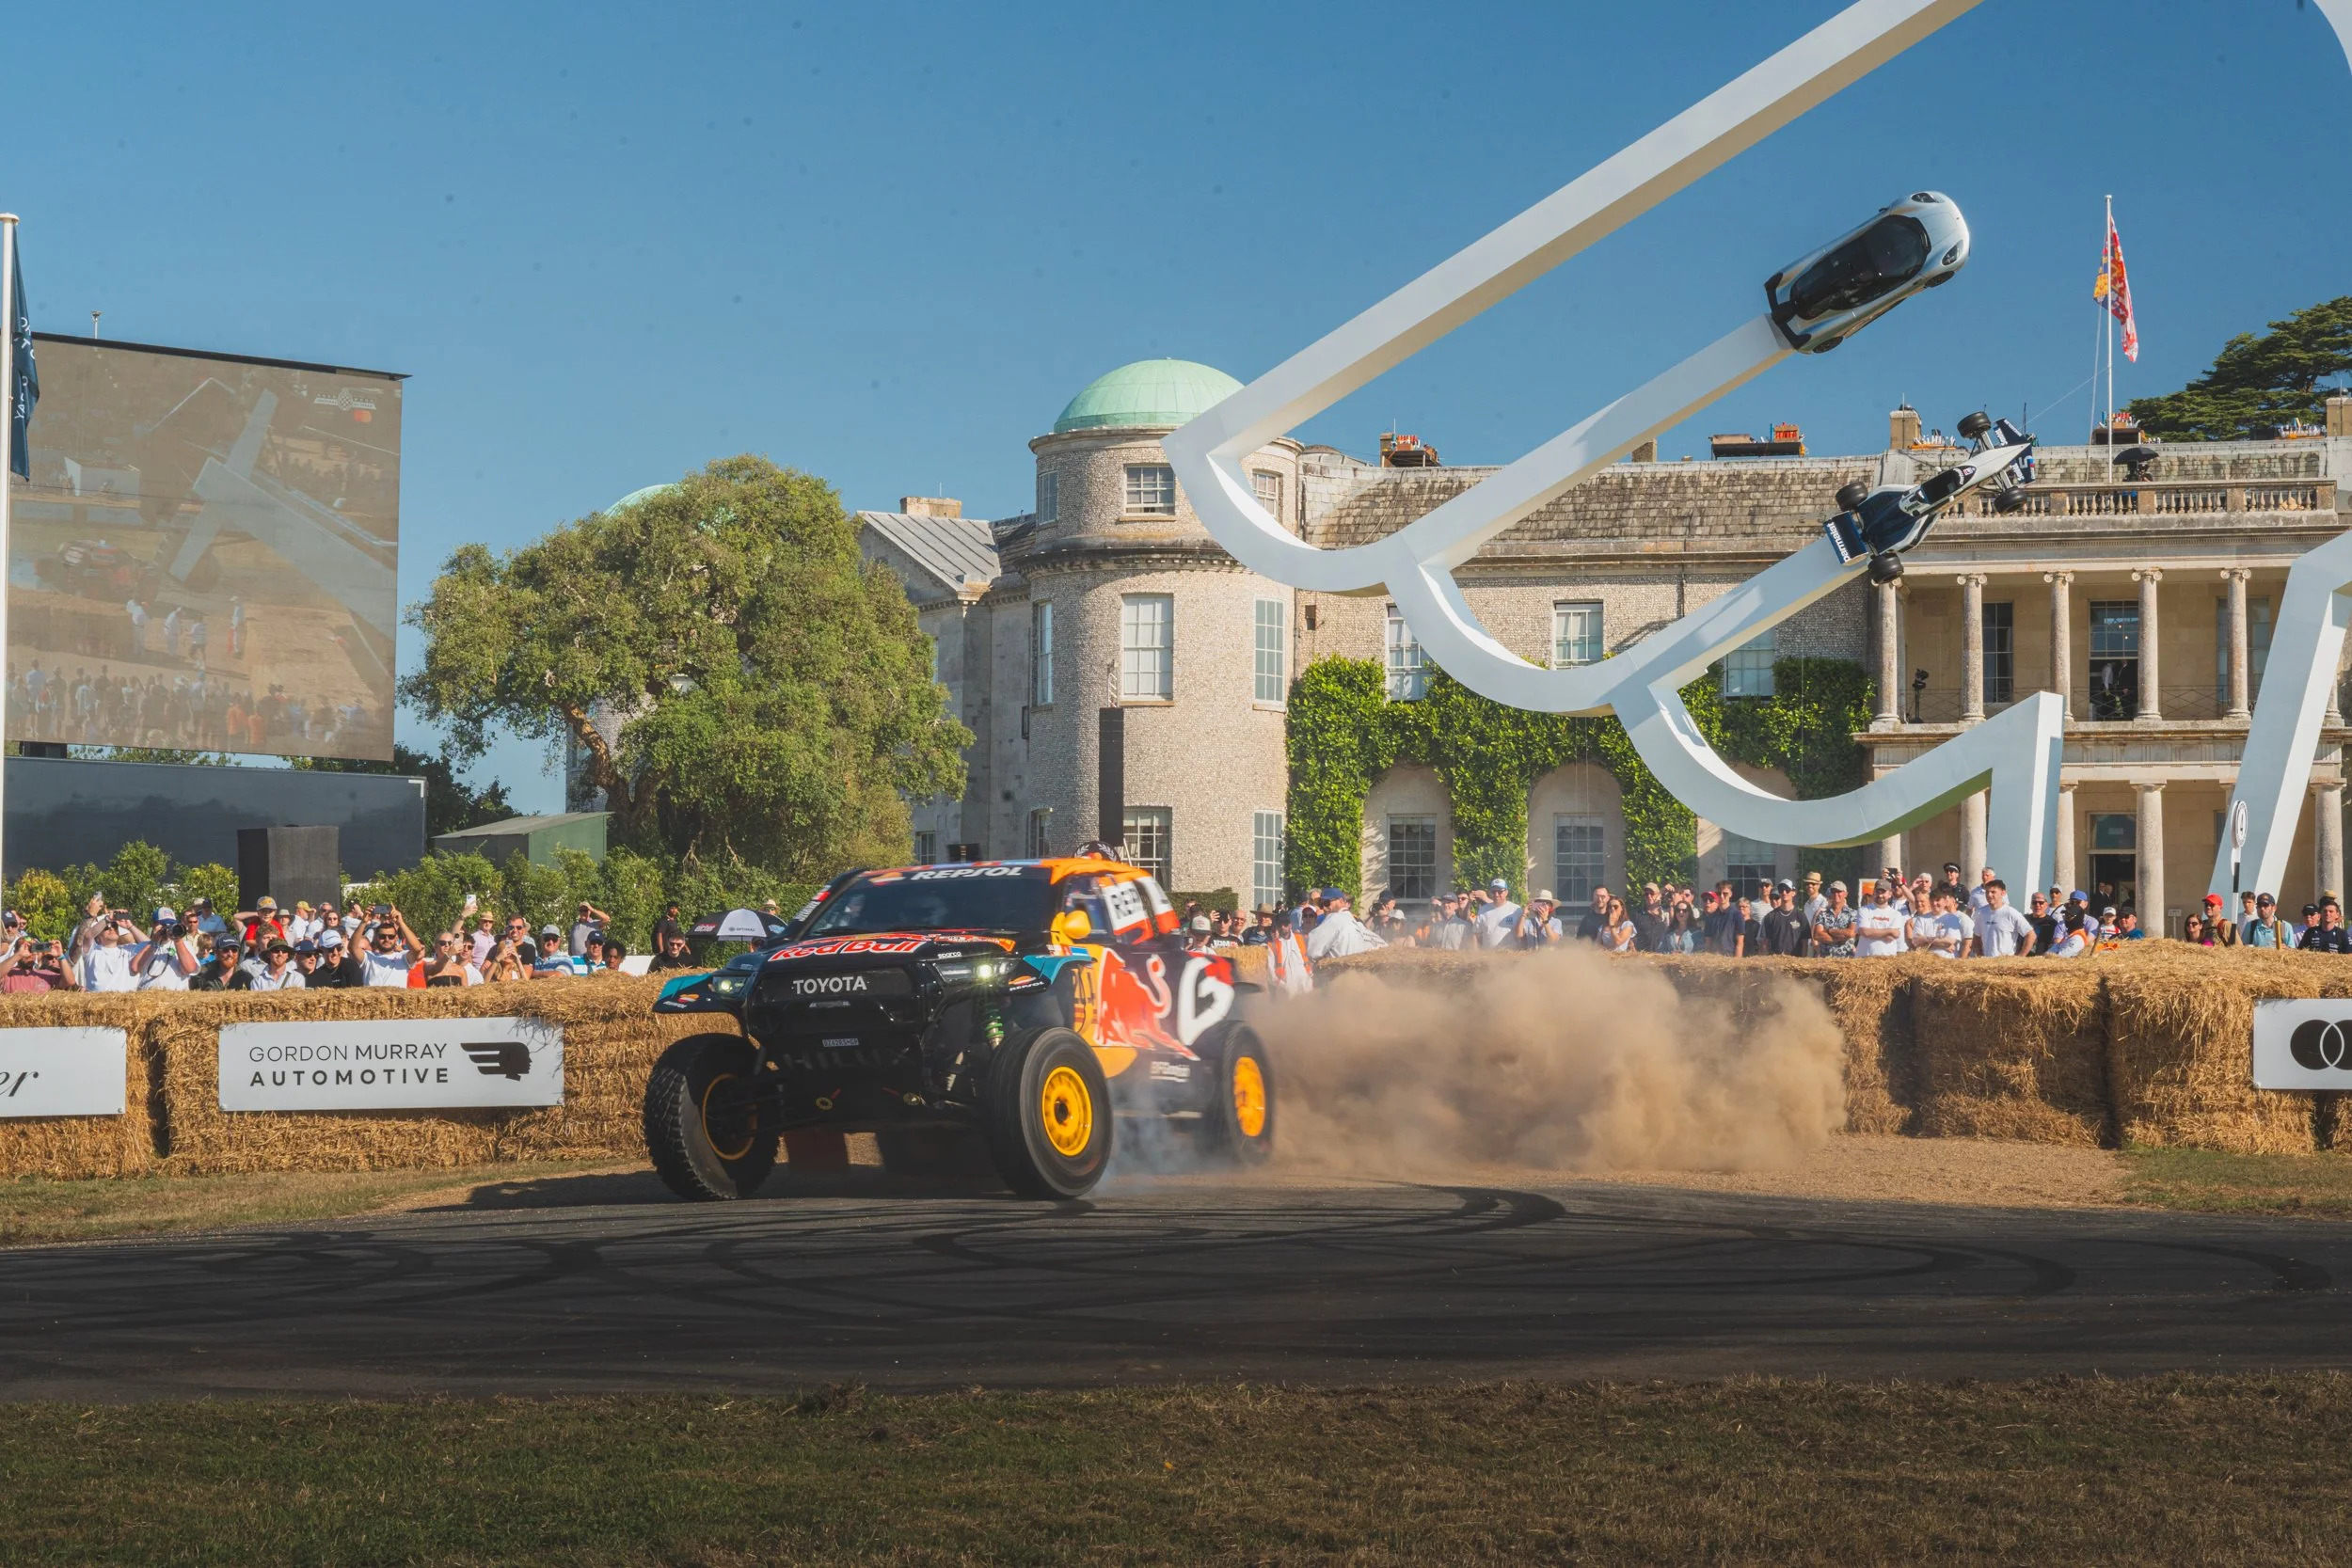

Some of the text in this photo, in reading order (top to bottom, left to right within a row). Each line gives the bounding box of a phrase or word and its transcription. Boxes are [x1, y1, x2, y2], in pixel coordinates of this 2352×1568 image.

[911, 866, 1023, 880] REPSOL
[767, 940, 928, 962] Red Bull
[792, 975, 867, 995] TOYOTA
[249, 1042, 448, 1062] GORDON MURRAY
[249, 1068, 449, 1087] AUTOMOTIVE
